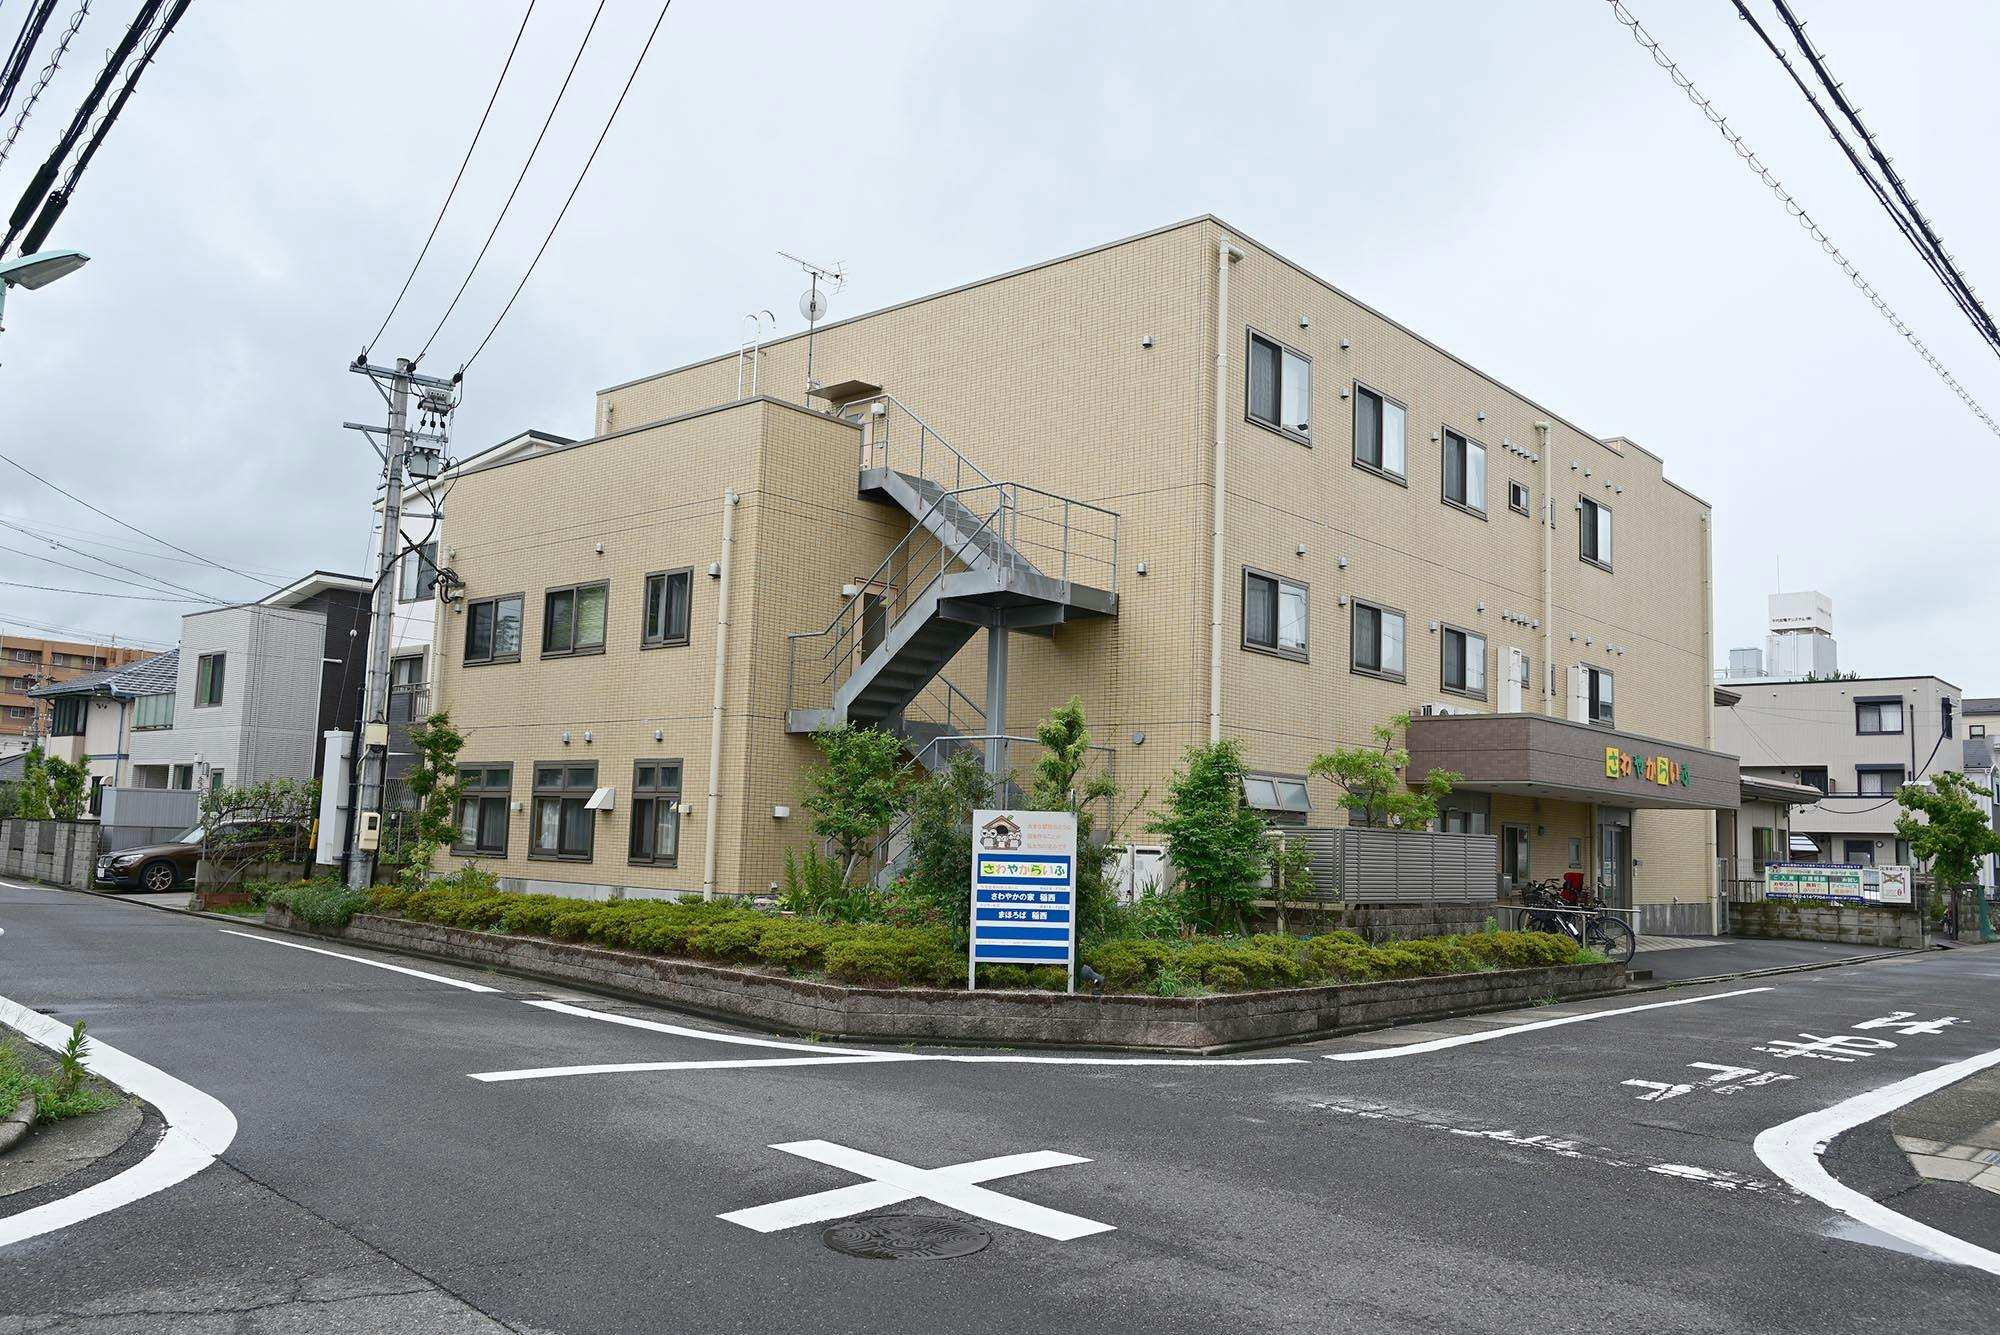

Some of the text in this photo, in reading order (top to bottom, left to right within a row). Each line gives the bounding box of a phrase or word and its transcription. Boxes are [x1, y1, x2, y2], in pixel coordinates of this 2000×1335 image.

[1604, 746, 1691, 787] さわやからいふ
[983, 863, 1065, 876] さわやからいふ
[991, 893, 1035, 901] さわやかの家
[998, 911, 1027, 919] まほろば
